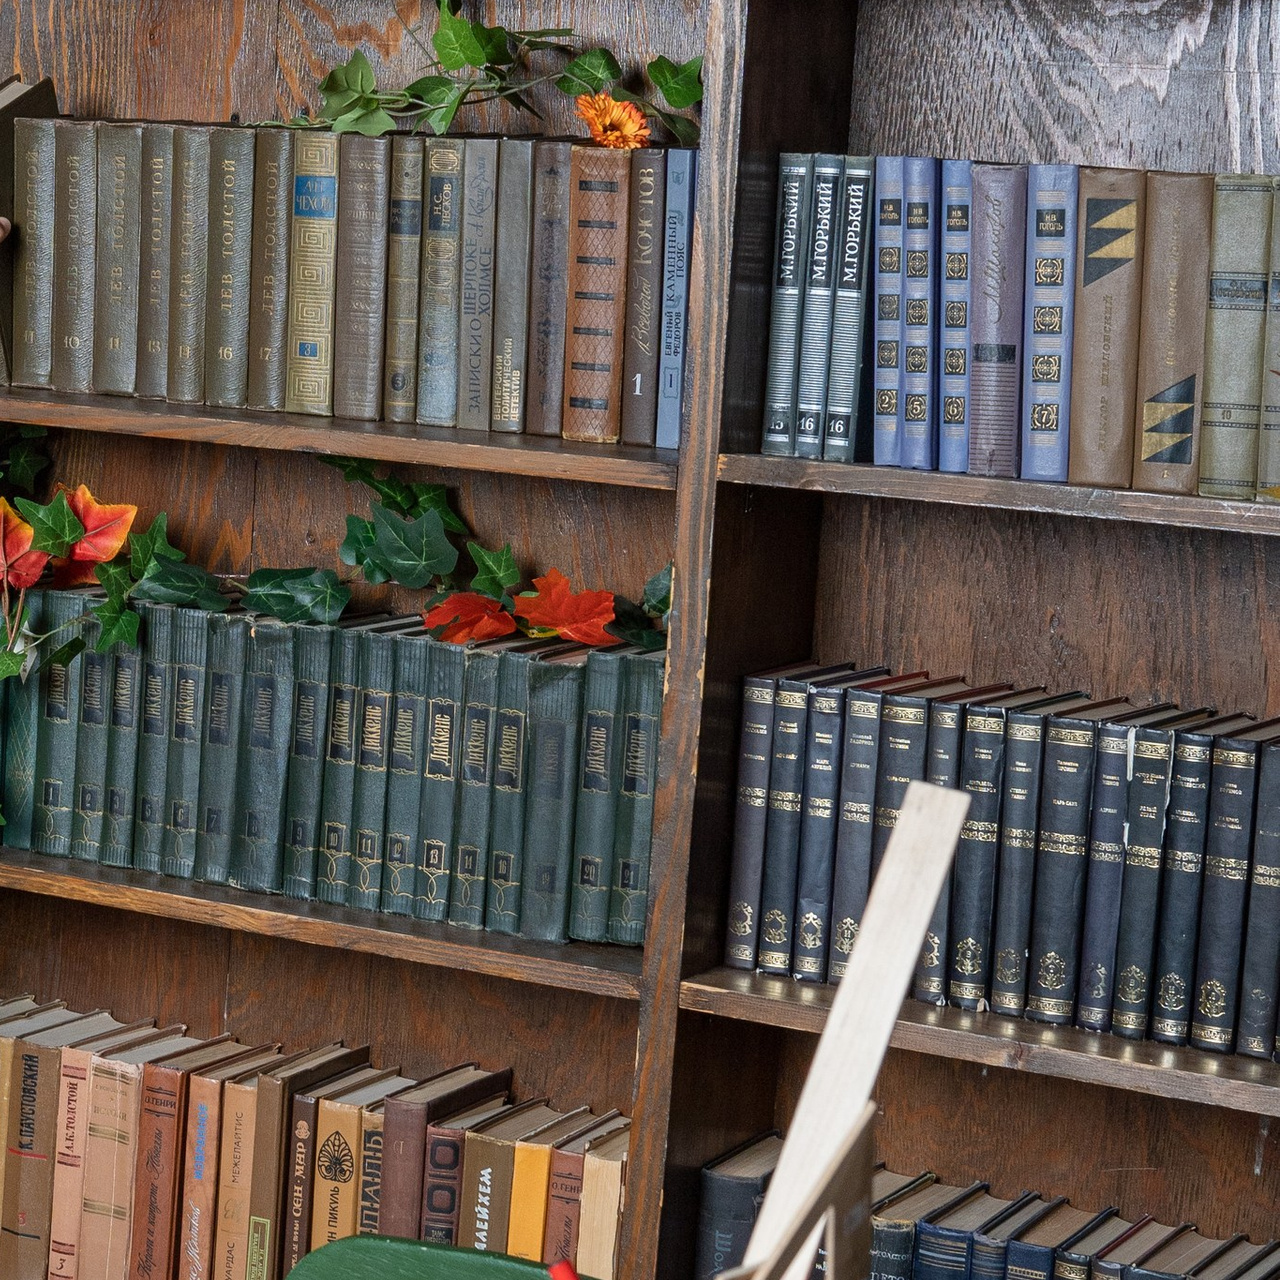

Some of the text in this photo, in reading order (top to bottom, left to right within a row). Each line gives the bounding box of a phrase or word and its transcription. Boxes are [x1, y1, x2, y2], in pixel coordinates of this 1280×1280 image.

[296, 193, 332, 210] ЧЕХОВ
[432, 192, 443, 215] Н.С.
[439, 182, 452, 227] ЛЕСКОВ
[634, 167, 654, 265] КОЧЕТОВ
[1038, 221, 1064, 232] ГОГОЛЬ
[65, 155, 81, 303] ЛЕВ ТОЛСТОЙ
[149, 156, 164, 309] ЛЕВ ТОЛСТОЙ
[220, 158, 236, 314] ЛЕВ ТОЛСТОЙ
[262, 160, 278, 315] ЛЕВ ТОЛСТОЙ
[780, 180, 799, 279] М.ГОРЬКИЙ
[812, 181, 833, 281] М.ГОРЬКИЙ
[843, 183, 864, 283] М.ГОРЬКИЙ
[463, 237, 477, 315] ШЕРЛОКЕ
[479, 247, 491, 317] ХОЛМСЕ
[668, 214, 678, 303] КАМЕННЫЙ
[676, 241, 686, 279] ПОЯС
[664, 310, 673, 357] ЕВГЕНИЙ
[673, 310, 682, 358] ФЕДОРОВ
[467, 317, 482, 413] ЗАПИСКИ О
[493, 354, 502, 422] ВЕНГЕРСКИЙ
[501, 336, 512, 422] ПОЛИТИЧЕСКИЙ
[631, 372, 643, 396] 1
[509, 369, 520, 421] ДЕТЕКТИВ
[881, 395, 890, 409] 2
[912, 401, 922, 415] 5
[949, 402, 958, 416] 6
[1040, 408, 1050, 424] 7
[799, 417, 814, 431] 16
[829, 418, 844, 433] 16
[177, 677, 195, 725] Диккенс
[331, 699, 351, 751] Диккенс
[363, 704, 382, 757] Диккенс
[393, 707, 414, 760] Диккенс
[429, 713, 451, 765] Диккенс
[465, 718, 485, 775] Диккенс
[498, 724, 518, 778] Диккенс
[585, 726, 606, 780] Диккенс
[626, 729, 646, 782] Диккенс
[19, 1053, 38, 1151] К.ПАУСТОВСКИЙ
[63, 1081, 78, 1154] А.К.ТОЛСТОЙ
[144, 1094, 176, 1110] О.ГЕНРИ
[146, 1127, 165, 1180] Новеллы
[194, 1102, 209, 1181] ИЗБРАННОЕ
[232, 1111, 245, 1185] МЕЖЕЛАЙТИС
[327, 1185, 341, 1231] ПИКУЛЬ
[56, 1257, 66, 1271] 3
